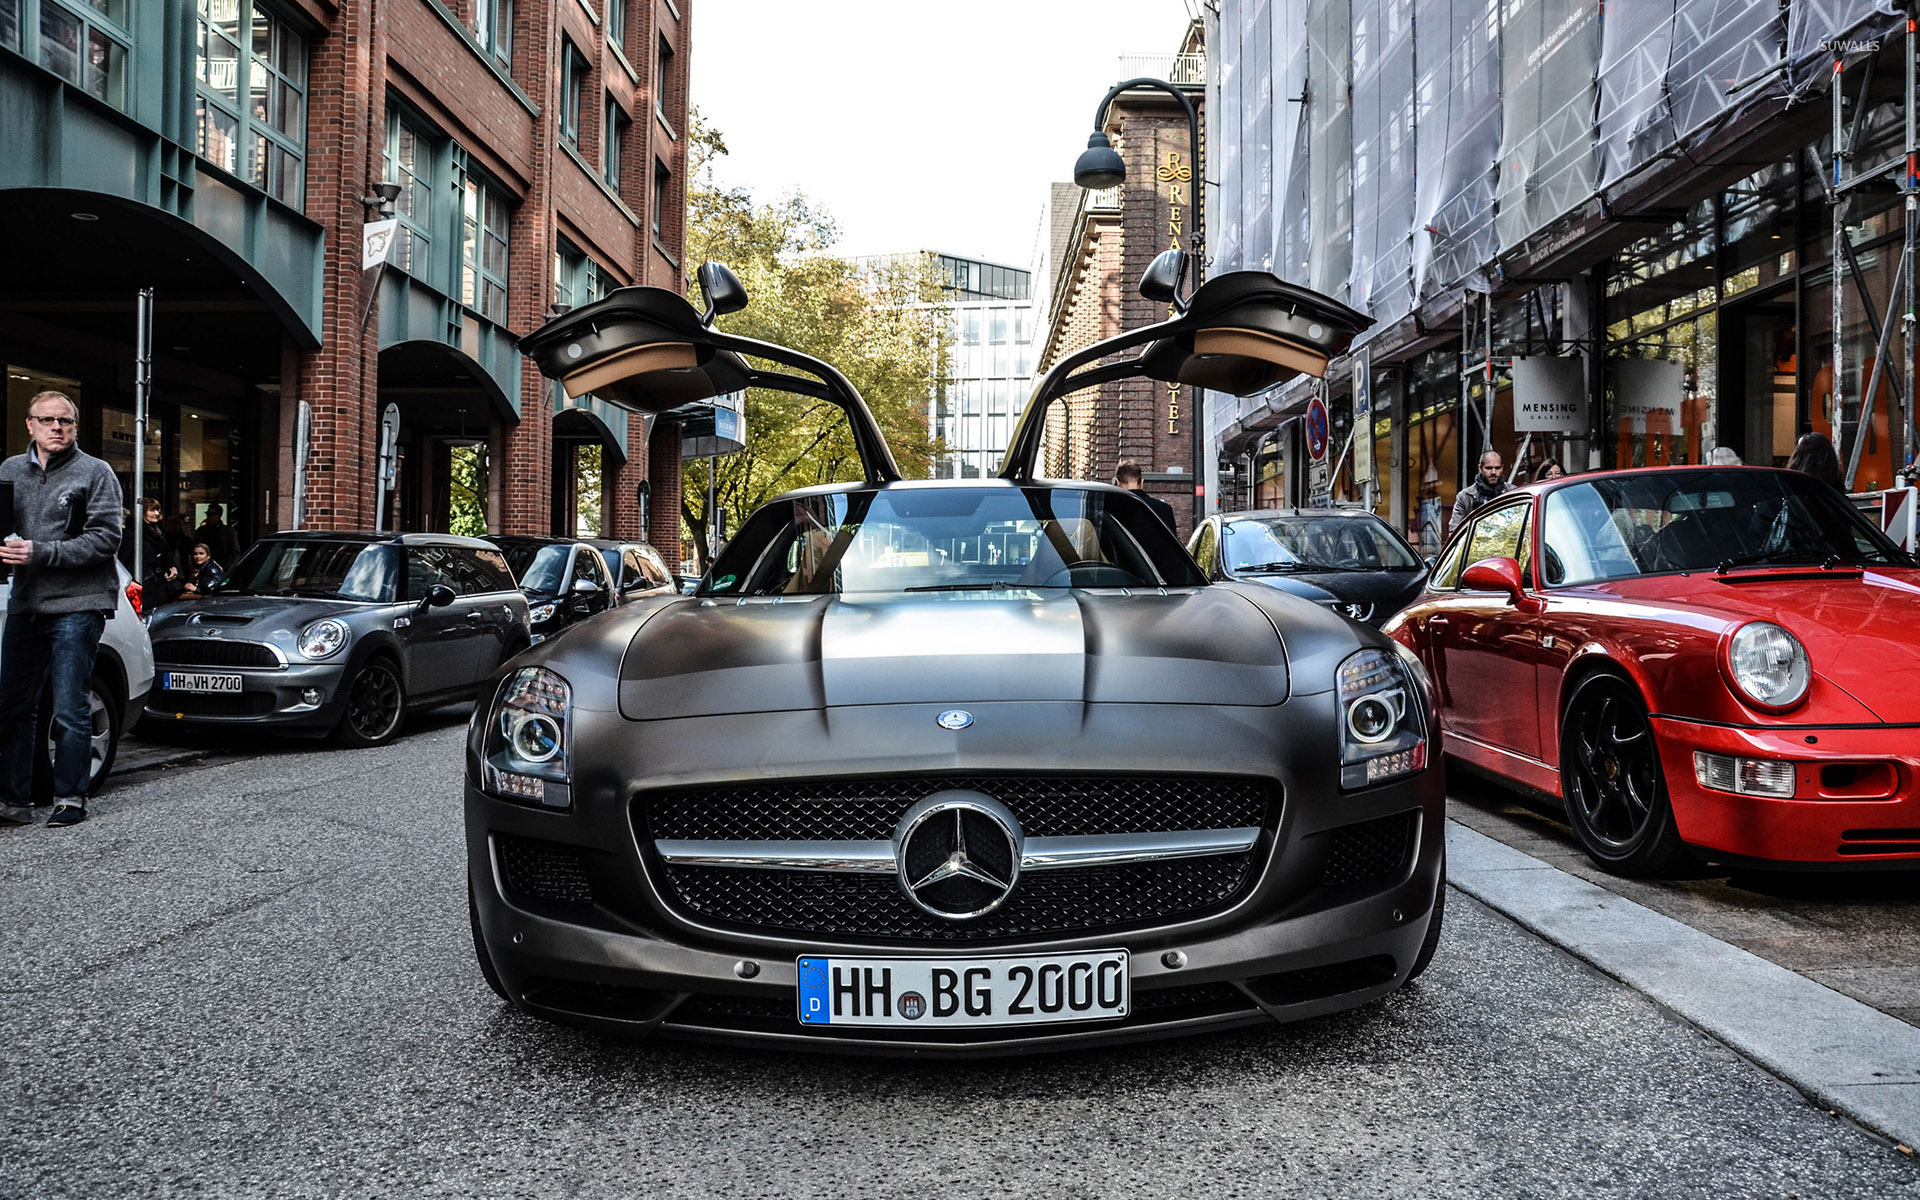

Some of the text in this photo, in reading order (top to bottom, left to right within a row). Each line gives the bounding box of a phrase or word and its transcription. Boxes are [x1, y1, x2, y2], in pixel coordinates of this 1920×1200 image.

[1529, 244, 1550, 266] BUCK
[1354, 360, 1365, 409] P
[1522, 403, 1578, 413] MENSING
[170, 674, 186, 689] HH
[193, 675, 209, 689] VH
[211, 676, 241, 690] 2700
[832, 959, 1123, 1018] HH BG 2000
[809, 997, 821, 1012] D
